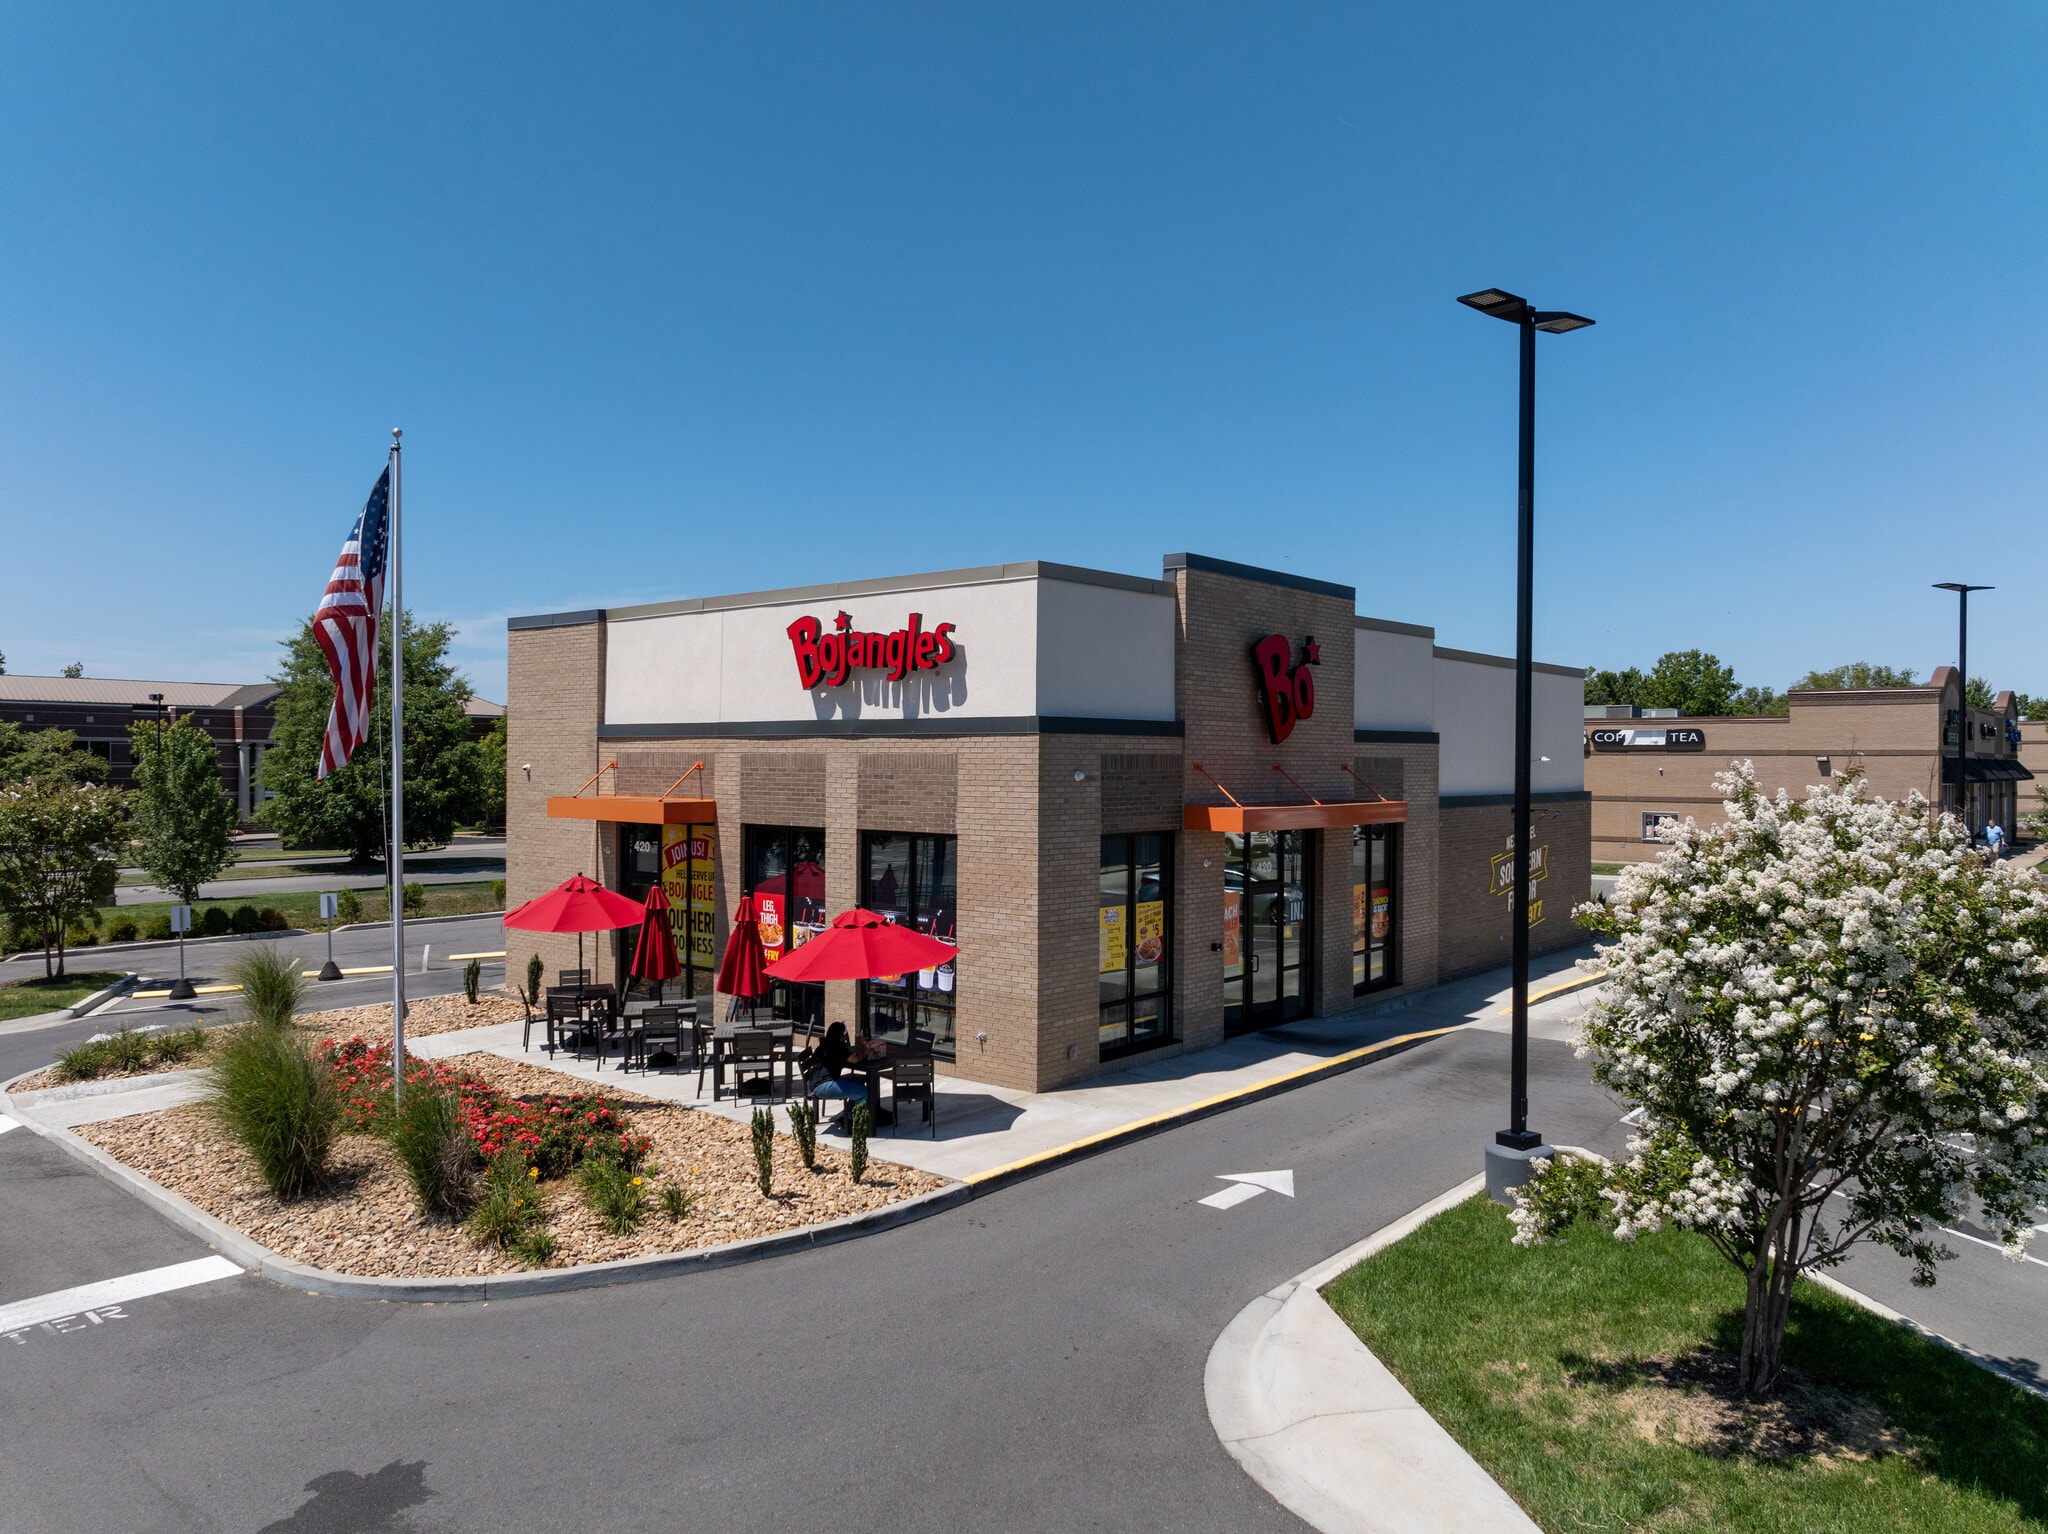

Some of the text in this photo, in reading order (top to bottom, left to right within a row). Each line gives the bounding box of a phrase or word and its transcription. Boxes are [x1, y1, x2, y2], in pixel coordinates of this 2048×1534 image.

[787, 610, 957, 691] Bojangles
[1251, 634, 1315, 744] Bo
[1669, 732, 1699, 742] TEA
[634, 840, 651, 852] 420
[676, 869, 687, 880] HEL
[1257, 861, 1272, 873] 420
[669, 881, 714, 902] BOJNGLE
[763, 899, 775, 913] LEG,
[1224, 904, 1238, 920] ACH
[1528, 900, 1542, 923] 977
[669, 908, 714, 935] OUHER
[760, 912, 778, 924] THIGH
[672, 934, 714, 955] OONESS
[767, 949, 780, 961] FRY
